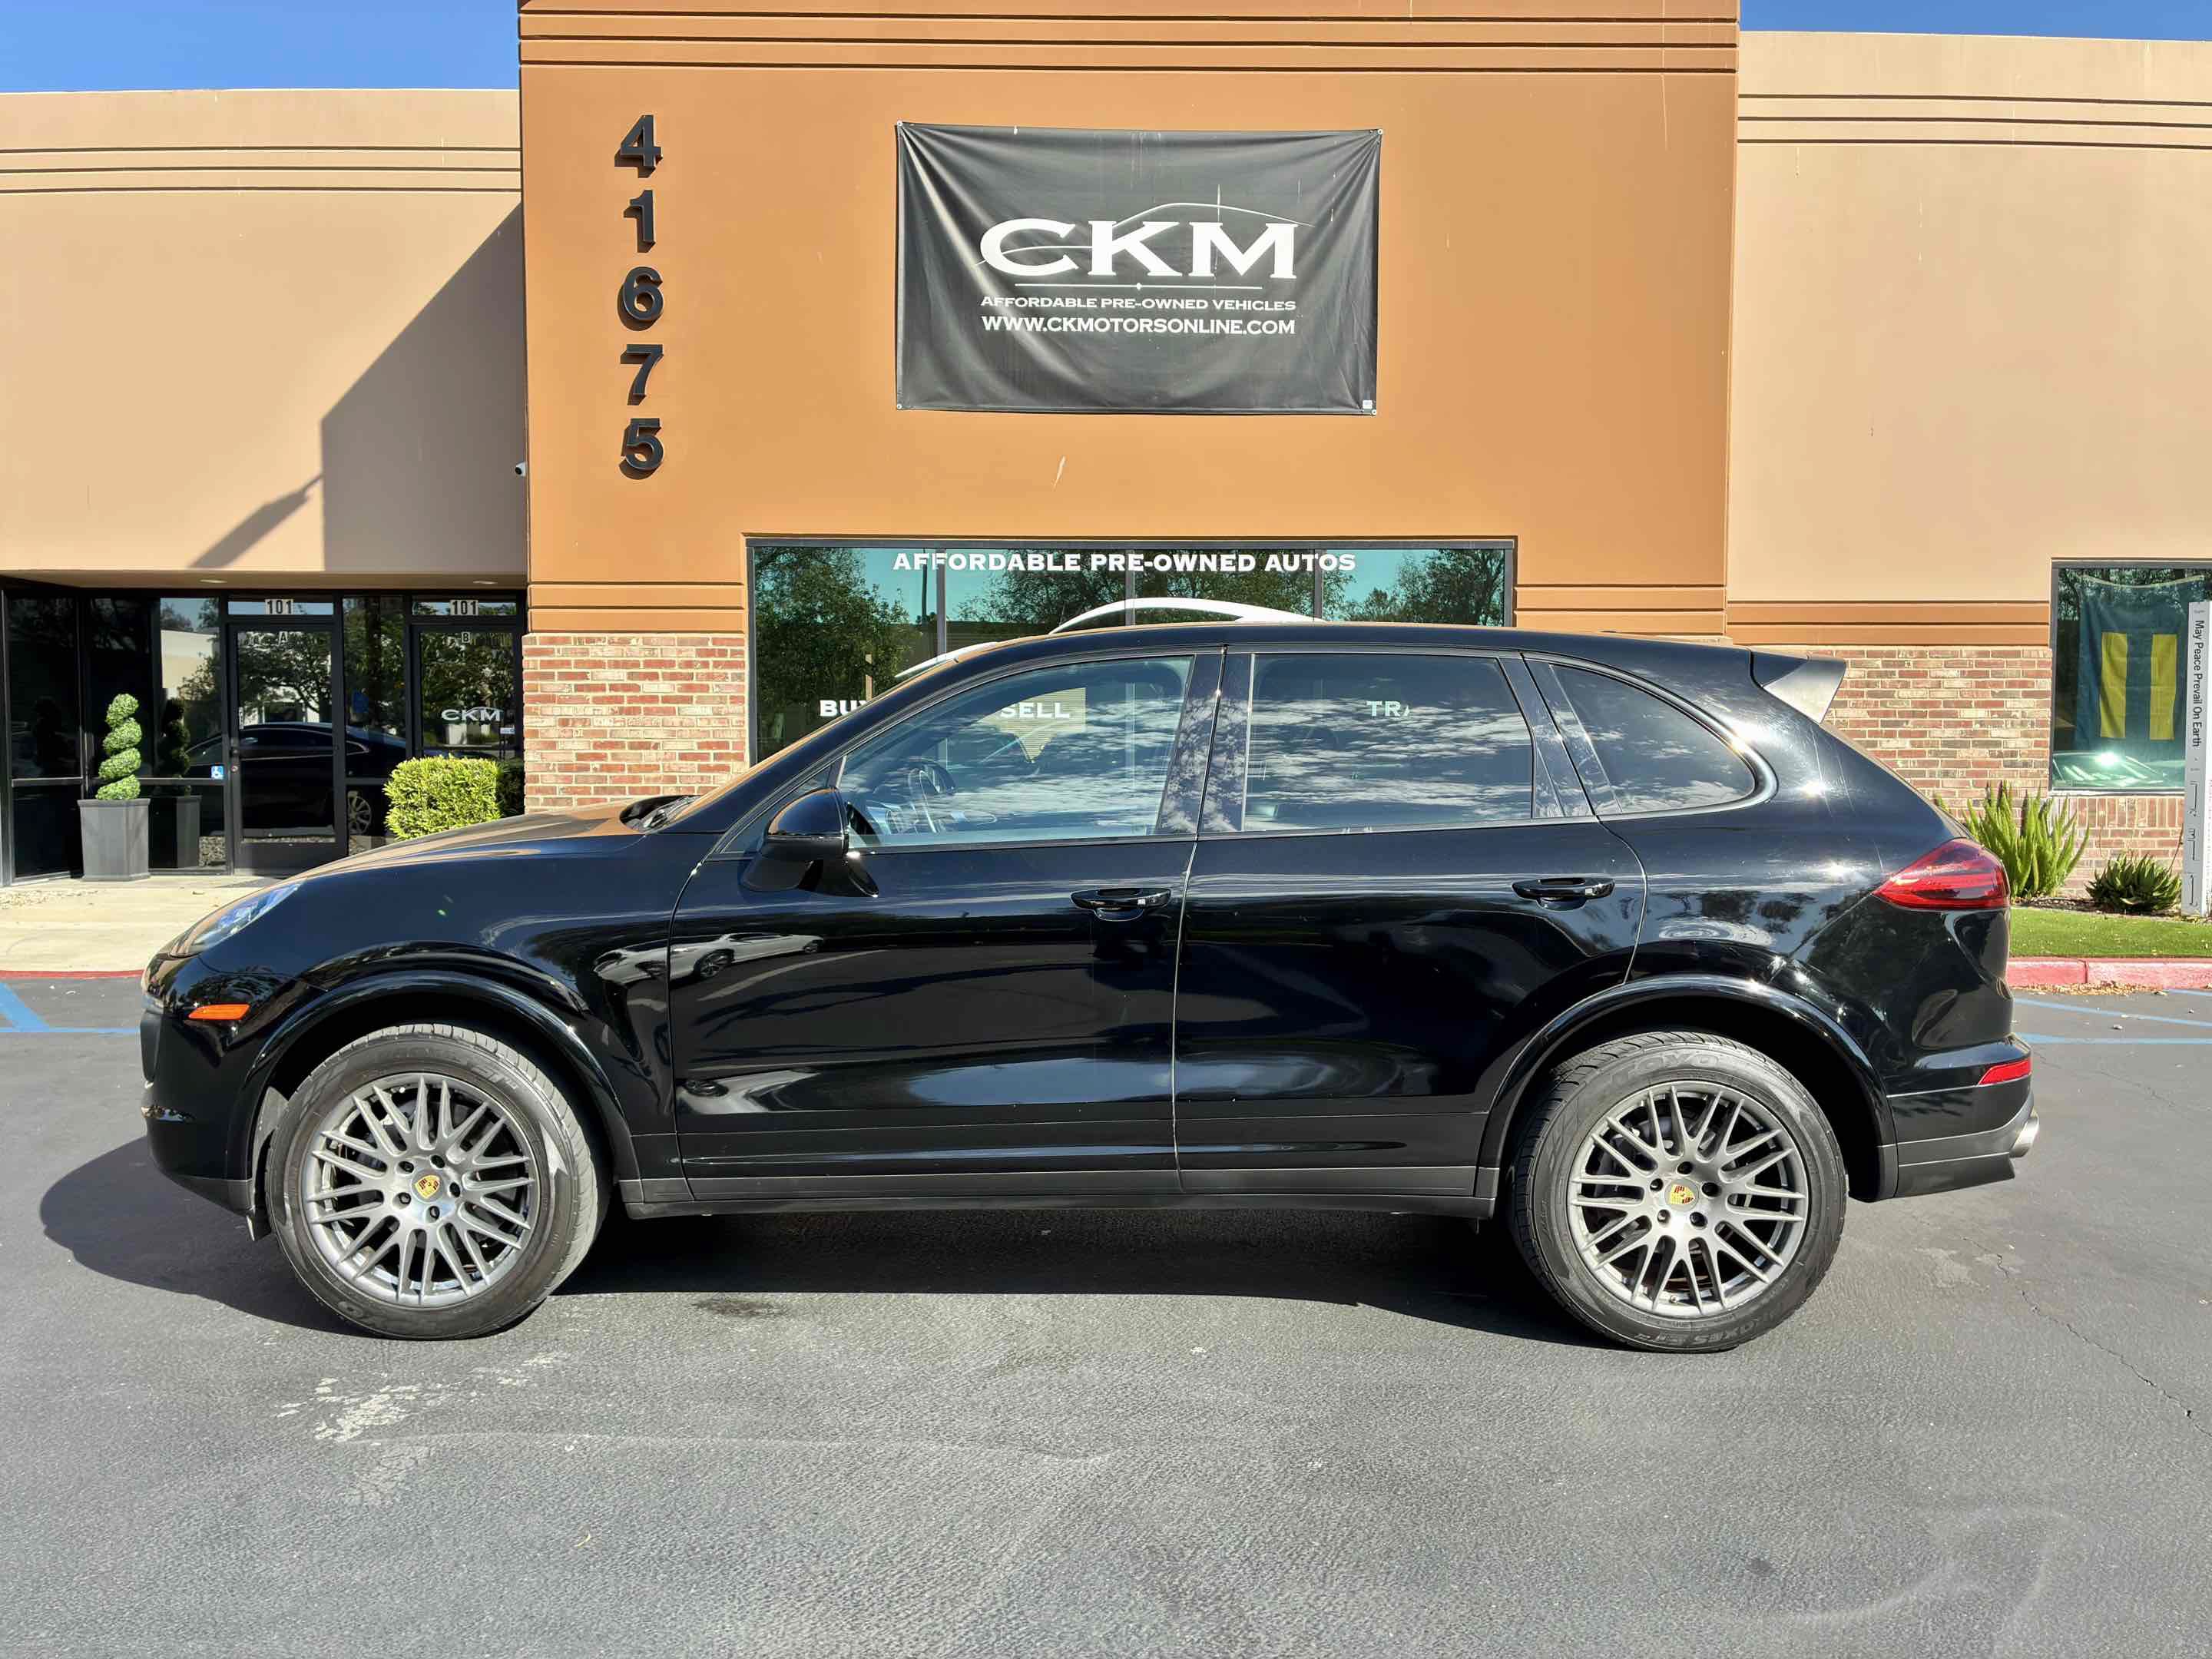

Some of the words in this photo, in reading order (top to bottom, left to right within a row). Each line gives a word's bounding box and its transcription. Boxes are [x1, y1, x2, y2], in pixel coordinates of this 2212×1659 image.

[979, 217, 1300, 279] CKM
[980, 296, 1098, 308] AFFORDABLE
[1101, 298, 1209, 310] PRE-OWNED
[1212, 300, 1296, 311] VEHICLES
[981, 316, 1296, 335] WWW.CKMOTORSONLINE.COM
[892, 552, 1082, 571] AFFORDABLE
[1090, 553, 1257, 571] PRE-OWNED
[1264, 553, 1356, 571] AUTOS
[267, 600, 293, 614] 101
[452, 600, 478, 615] 101
[280, 631, 288, 642] A
[462, 632, 469, 642] B
[2193, 620, 2205, 640] May
[2194, 642, 2204, 671] Peace
[2193, 673, 2204, 704] Prevail
[441, 708, 502, 722] CKM
[819, 700, 866, 717] BU
[1000, 702, 1070, 719] SELL
[2193, 706, 2203, 720] On
[2192, 721, 2203, 747] Earth
